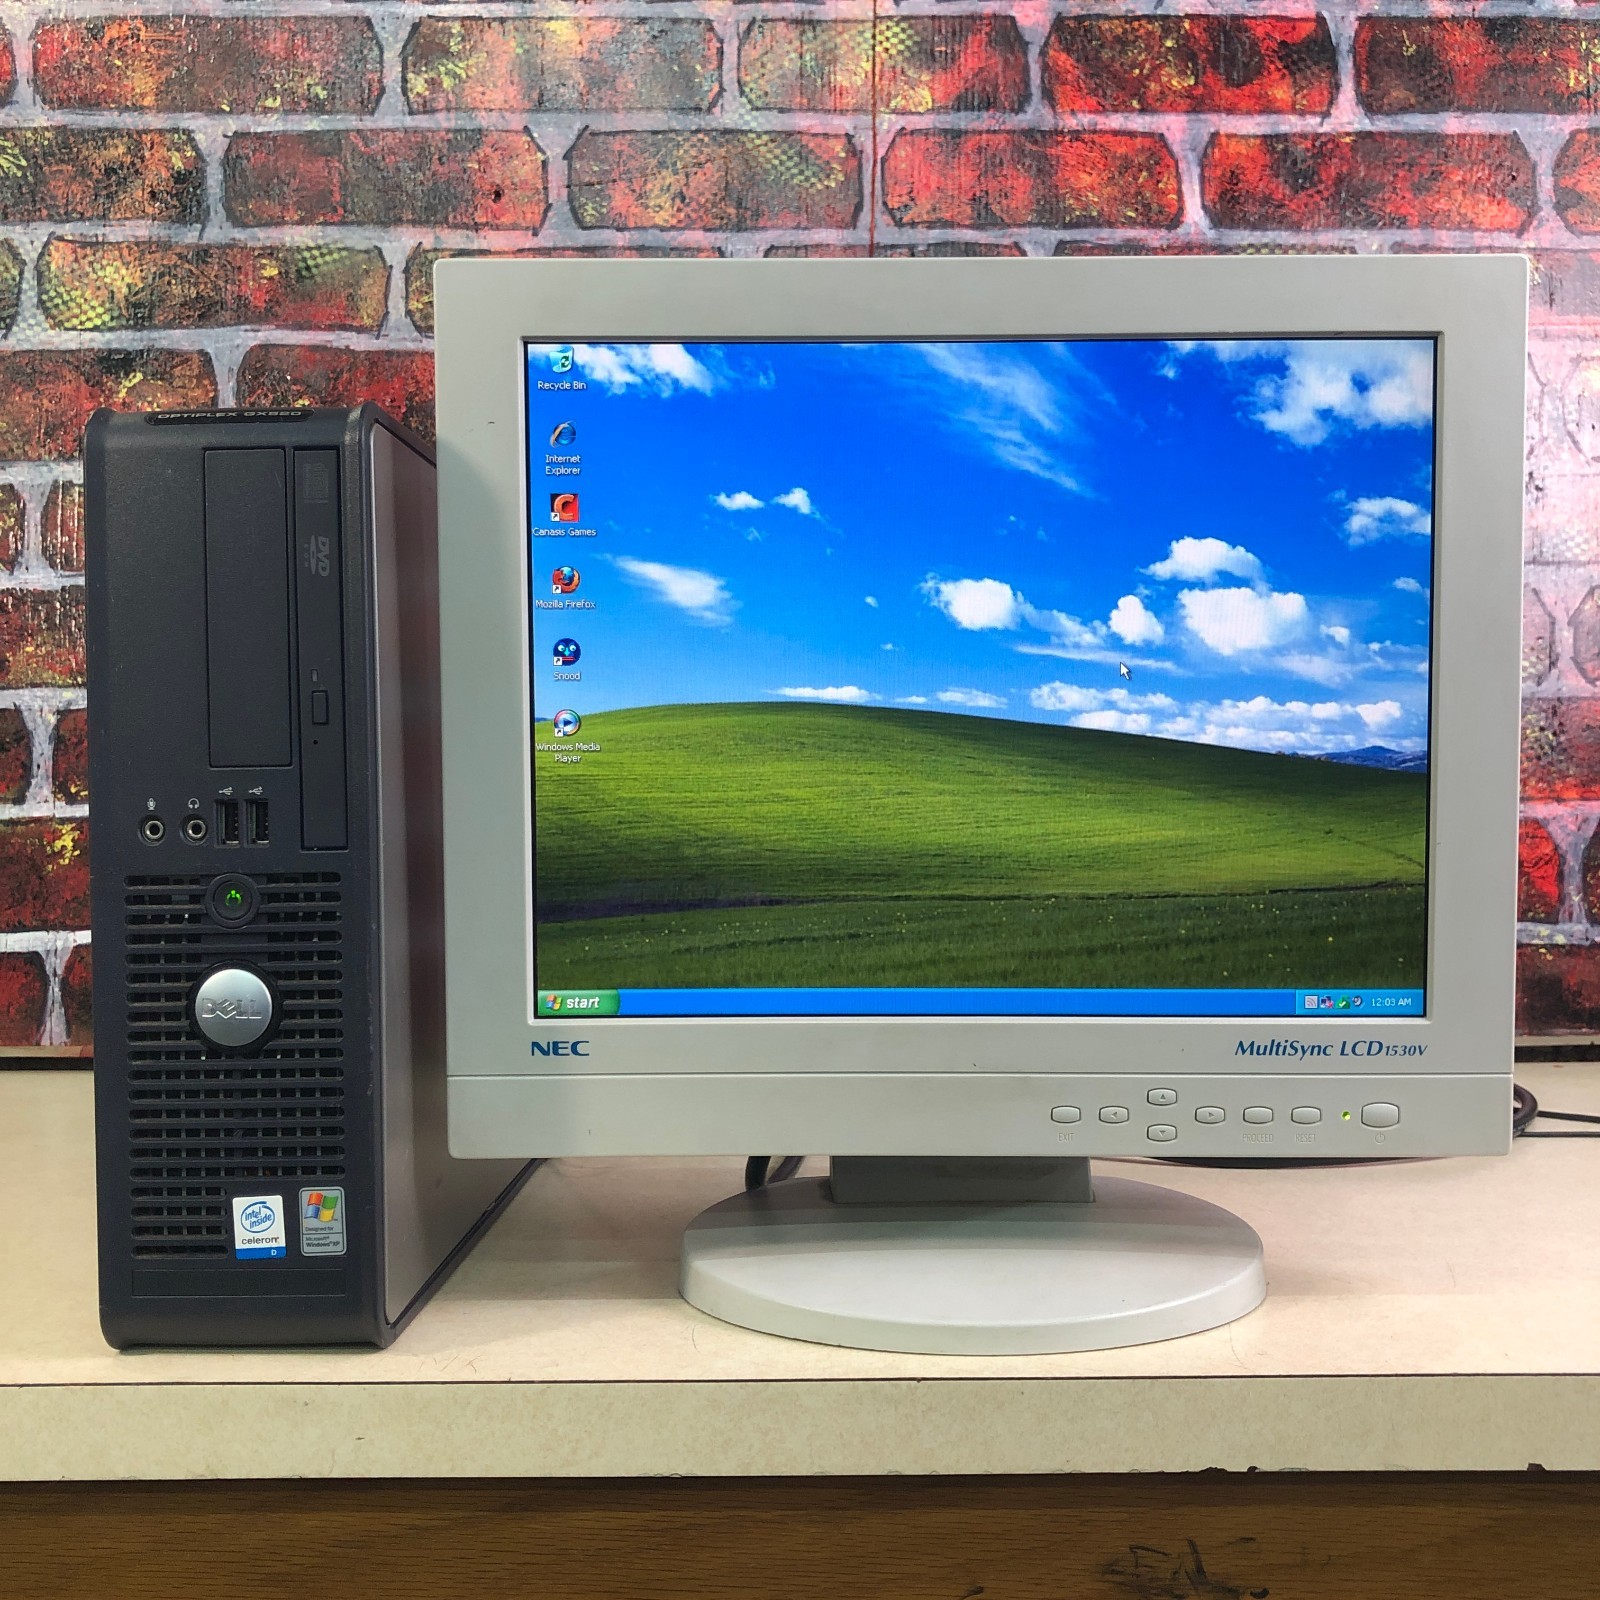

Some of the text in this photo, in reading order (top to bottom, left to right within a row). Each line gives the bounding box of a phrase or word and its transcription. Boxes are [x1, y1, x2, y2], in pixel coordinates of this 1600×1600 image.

[538, 381, 587, 391] Recycle Bin
[545, 455, 581, 463] Internet
[545, 466, 581, 476] Explorer
[532, 528, 597, 536] Canasis Games
[317, 535, 330, 577] DVD
[535, 600, 596, 608] Mozilla Firefox
[553, 672, 581, 680] Snood
[535, 743, 601, 751] Windows Media
[554, 755, 582, 764] Player
[566, 997, 600, 1009] start
[1371, 998, 1412, 1007] 12:03 AM
[531, 1041, 590, 1057] NEC
[1234, 1039, 1334, 1061] MultiSync
[1058, 1132, 1074, 1142] EXIT
[1242, 1133, 1274, 1143] PROCEED
[1295, 1133, 1317, 1143] RESET
[245, 1206, 262, 1221] intel
[249, 1213, 273, 1229] inside
